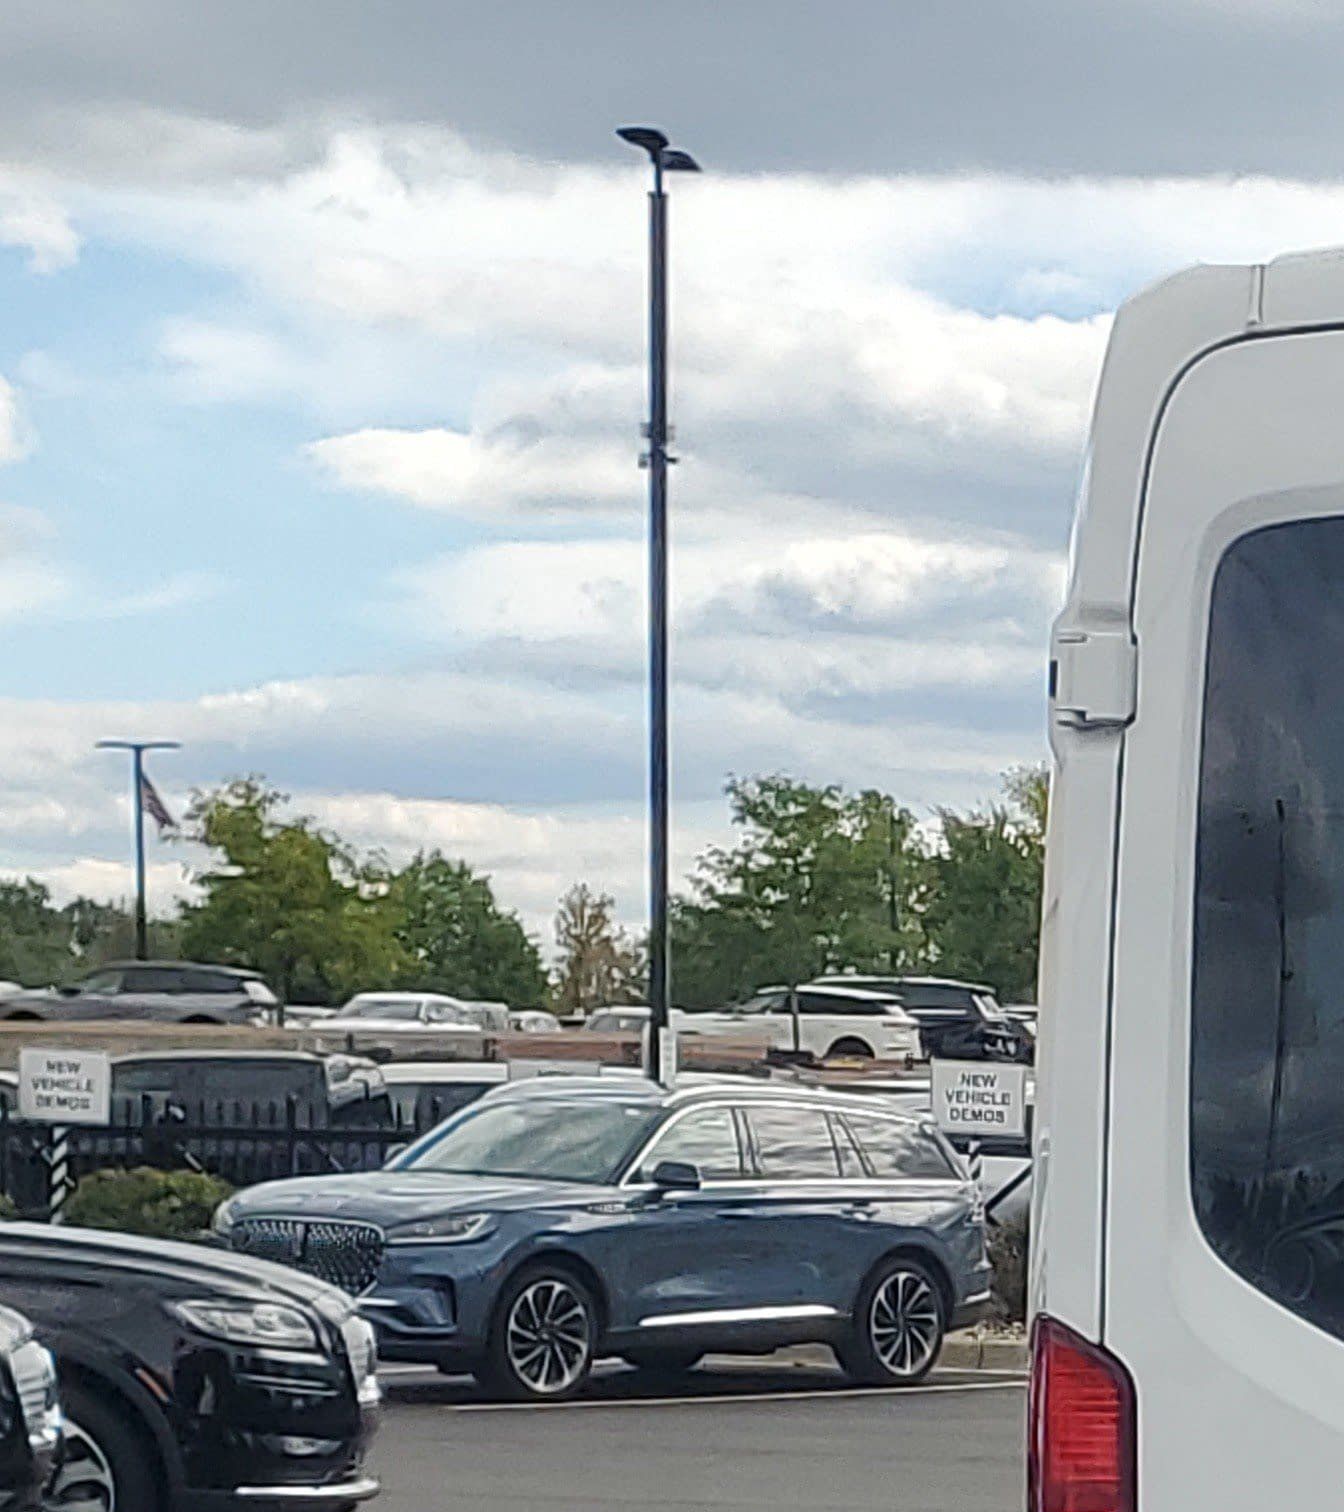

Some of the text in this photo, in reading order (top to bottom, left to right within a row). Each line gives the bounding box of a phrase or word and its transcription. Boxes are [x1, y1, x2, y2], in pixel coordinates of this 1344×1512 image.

[961, 1073, 997, 1087] NEW
[946, 1089, 1011, 1106] VEHICLE
[950, 1107, 1005, 1123] DEMOS
